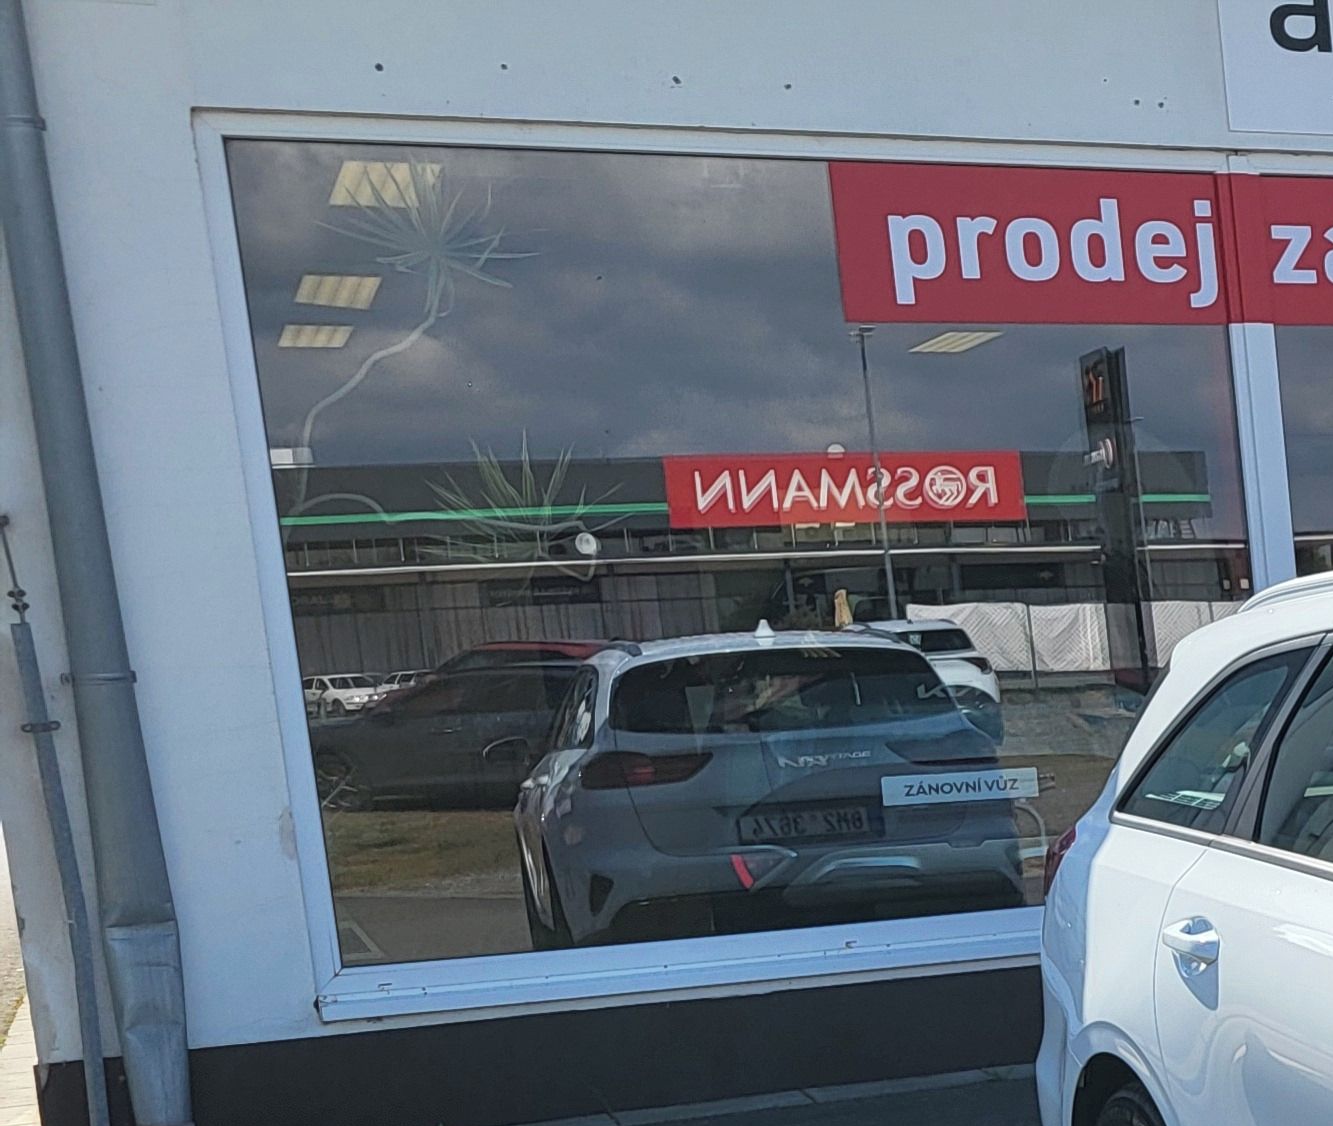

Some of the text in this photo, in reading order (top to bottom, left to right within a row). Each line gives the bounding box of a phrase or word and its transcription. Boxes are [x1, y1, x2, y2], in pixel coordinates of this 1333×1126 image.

[887, 198, 1219, 308] prodej
[904, 775, 1019, 797] ZÁNOVNÍ VŮZ
